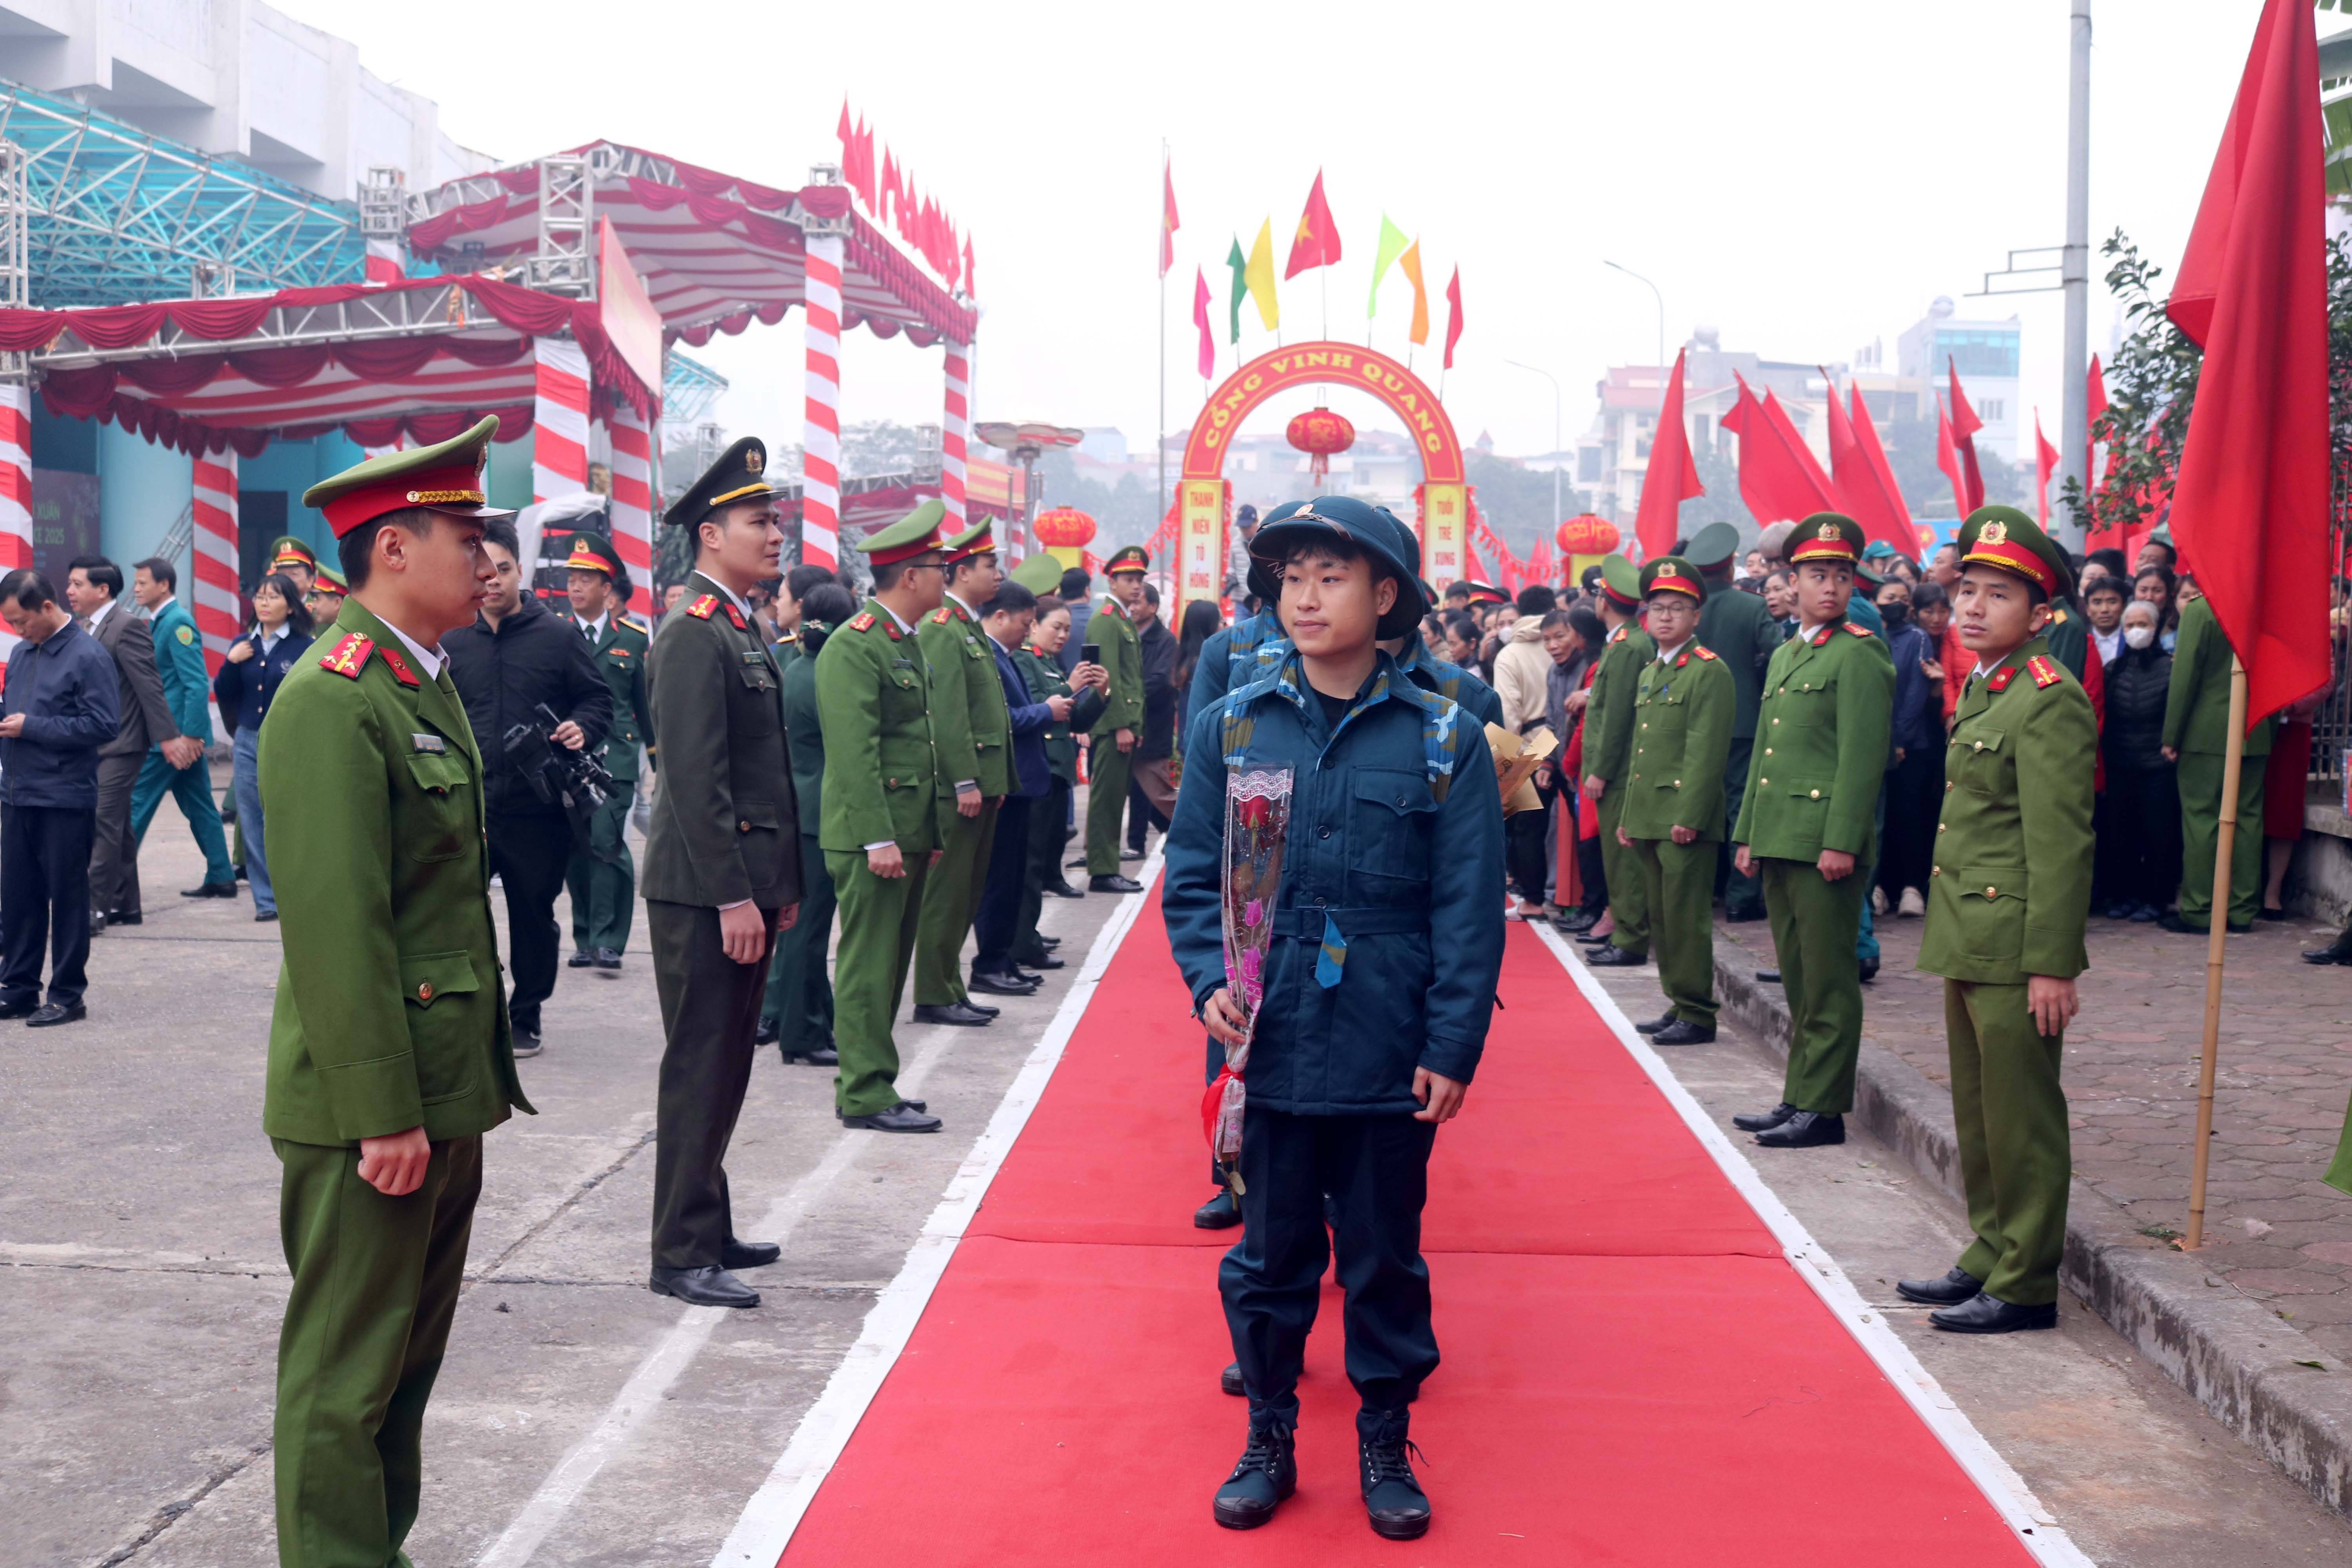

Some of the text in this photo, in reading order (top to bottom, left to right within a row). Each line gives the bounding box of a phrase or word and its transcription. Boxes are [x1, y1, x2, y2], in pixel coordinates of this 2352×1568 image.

[1269, 352, 1354, 373] VINH
[1361, 363, 1441, 454] QUANG
[1190, 492, 1214, 507] THANH
[1192, 515, 1210, 534] NIÊN
[1435, 552, 1455, 565] XUNG
